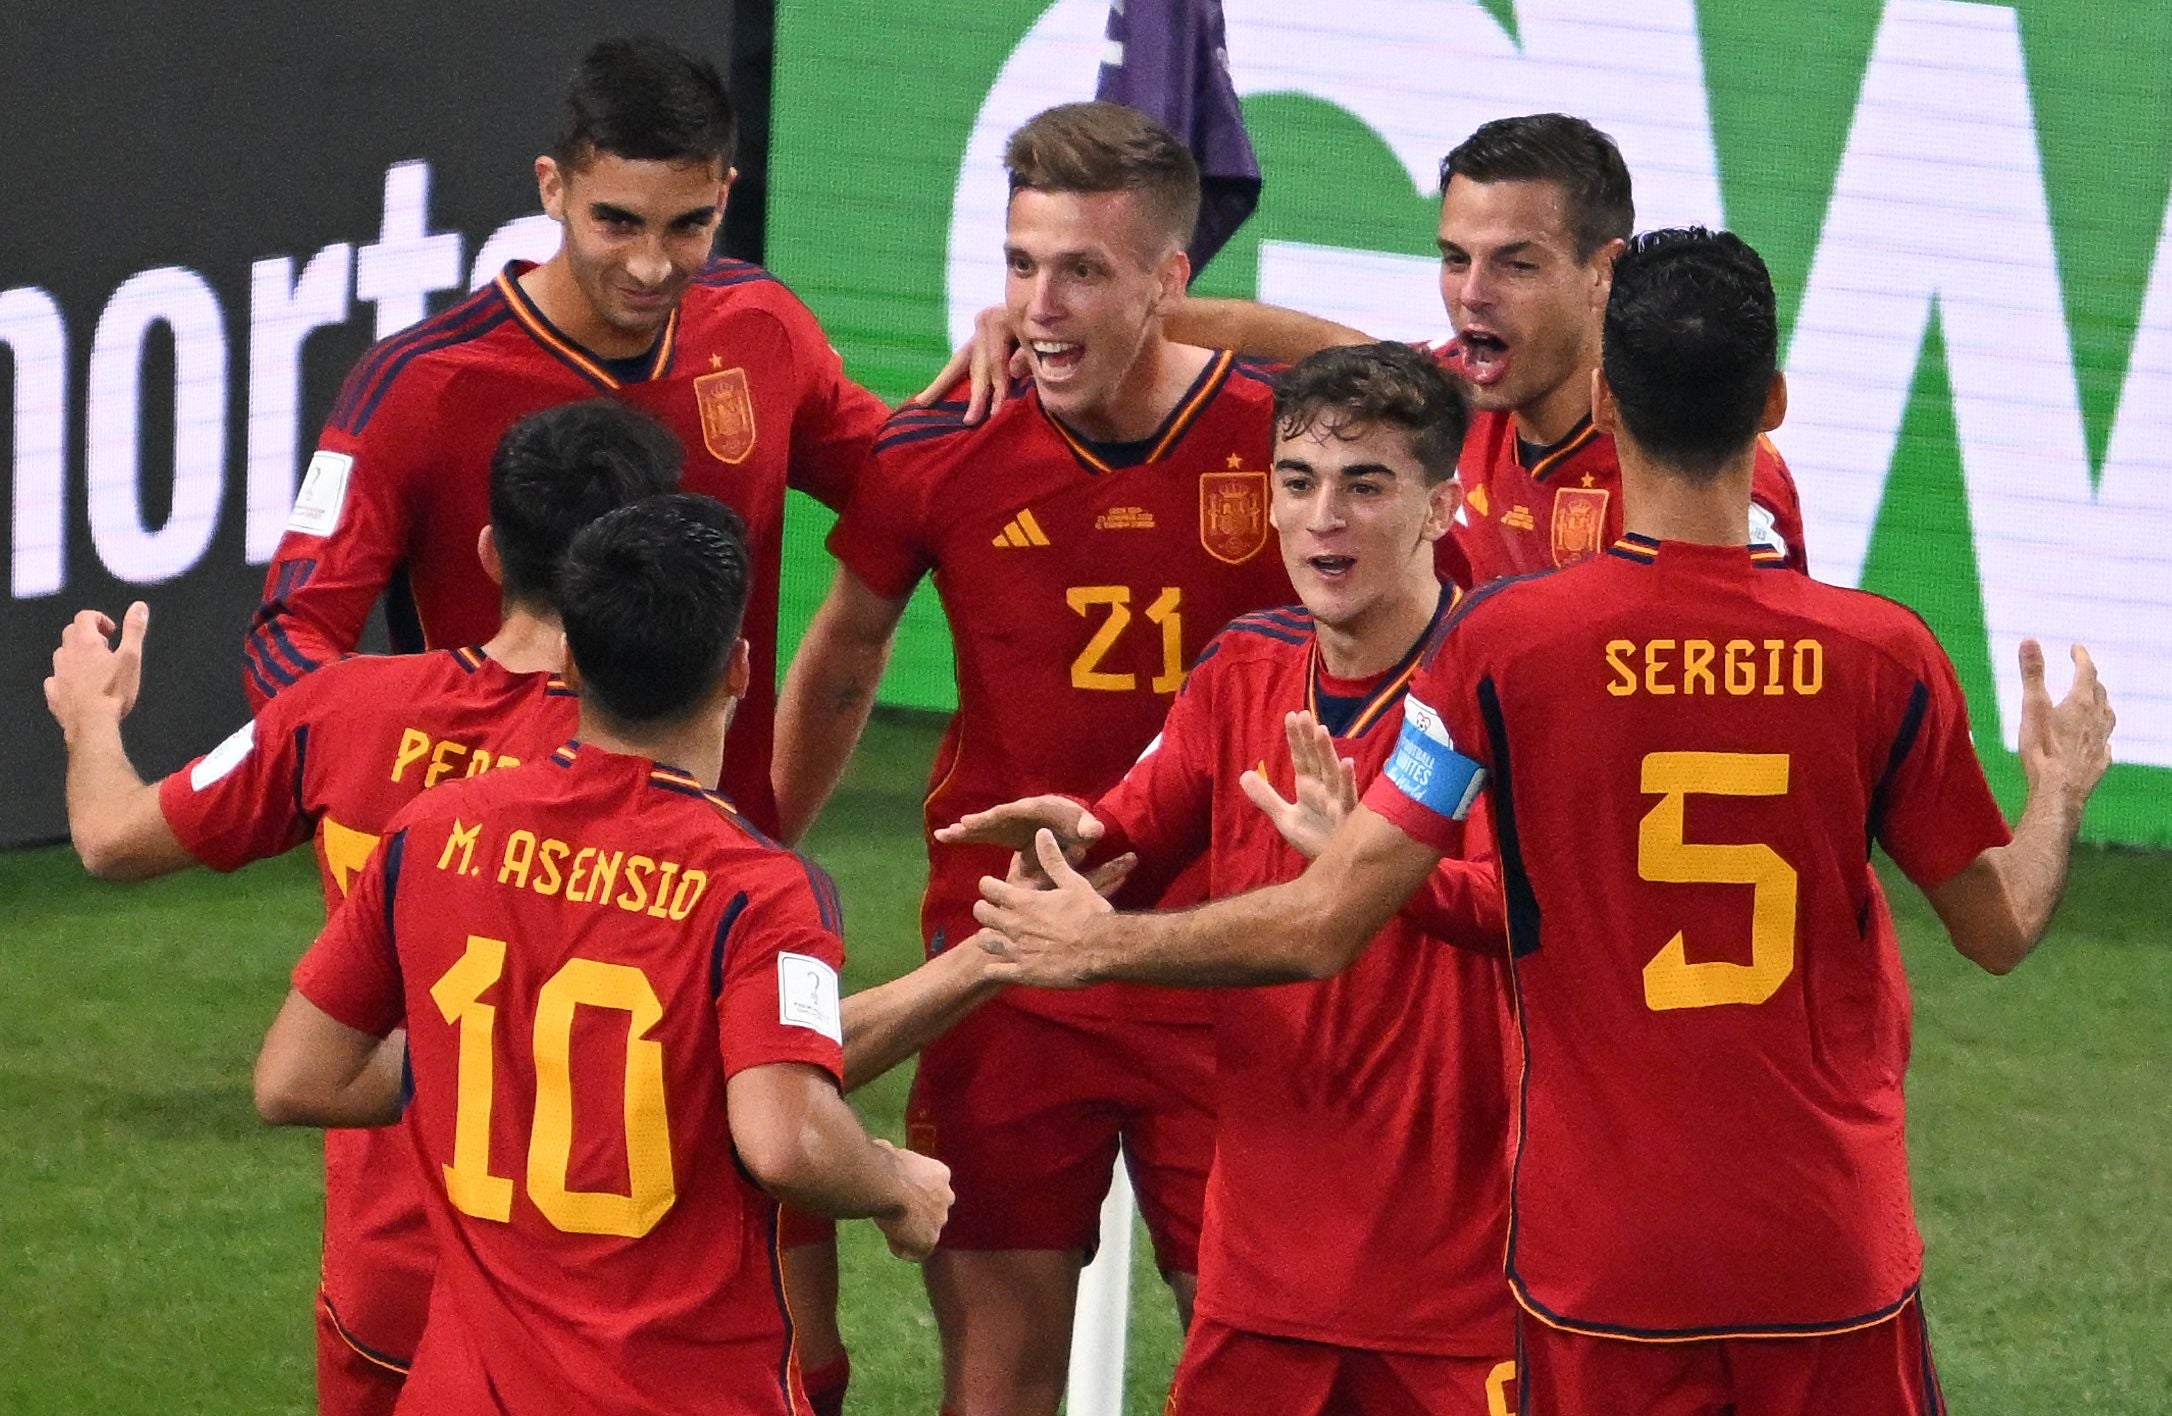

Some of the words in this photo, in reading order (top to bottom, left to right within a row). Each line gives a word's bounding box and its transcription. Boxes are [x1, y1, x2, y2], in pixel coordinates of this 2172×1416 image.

[1066, 585, 1188, 694] 21
[1605, 639, 1823, 696] SERGIO
[436, 817, 483, 877] M.
[497, 829, 707, 921] ASENSIO
[1638, 751, 1798, 1011] 5
[429, 936, 676, 1239] 10
